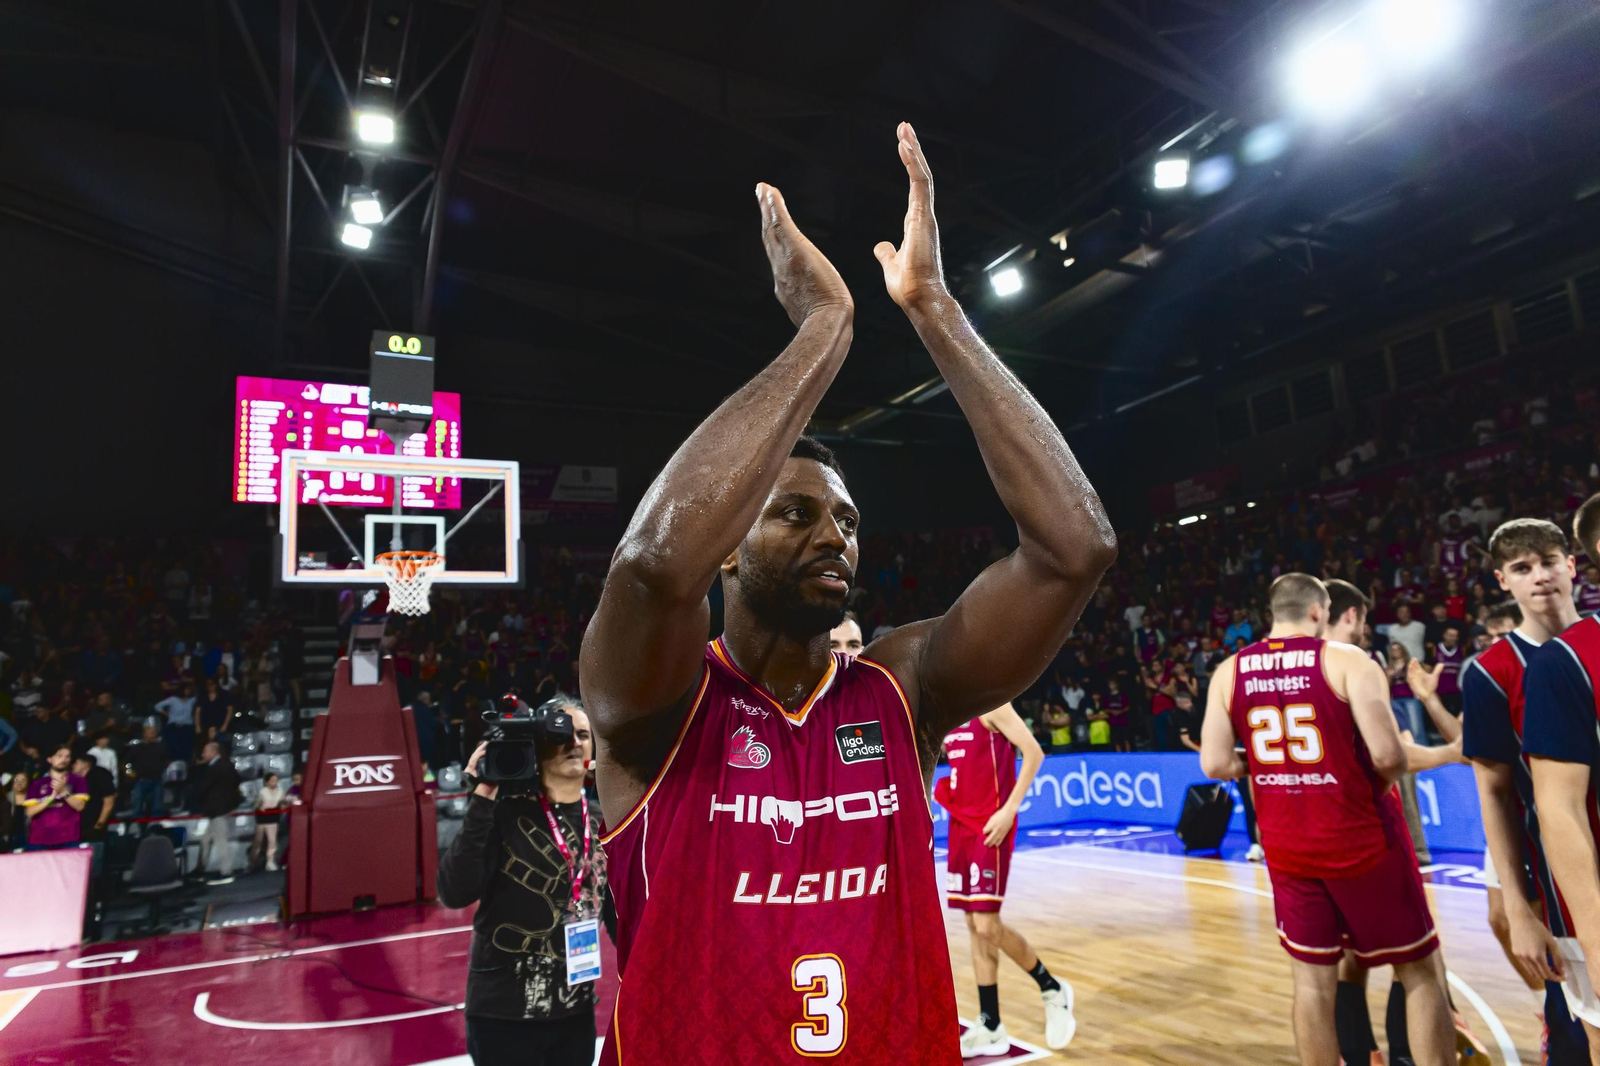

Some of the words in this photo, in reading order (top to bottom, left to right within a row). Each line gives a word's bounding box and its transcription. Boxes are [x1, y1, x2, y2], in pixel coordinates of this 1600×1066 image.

[388, 334, 422, 355] 0.0
[1240, 650, 1316, 674] KRUTWIG
[842, 736, 864, 748] liga
[1247, 703, 1325, 765] 25
[333, 763, 395, 787] PONS
[733, 863, 887, 904] LLEIDA
[790, 952, 849, 1058] 3
